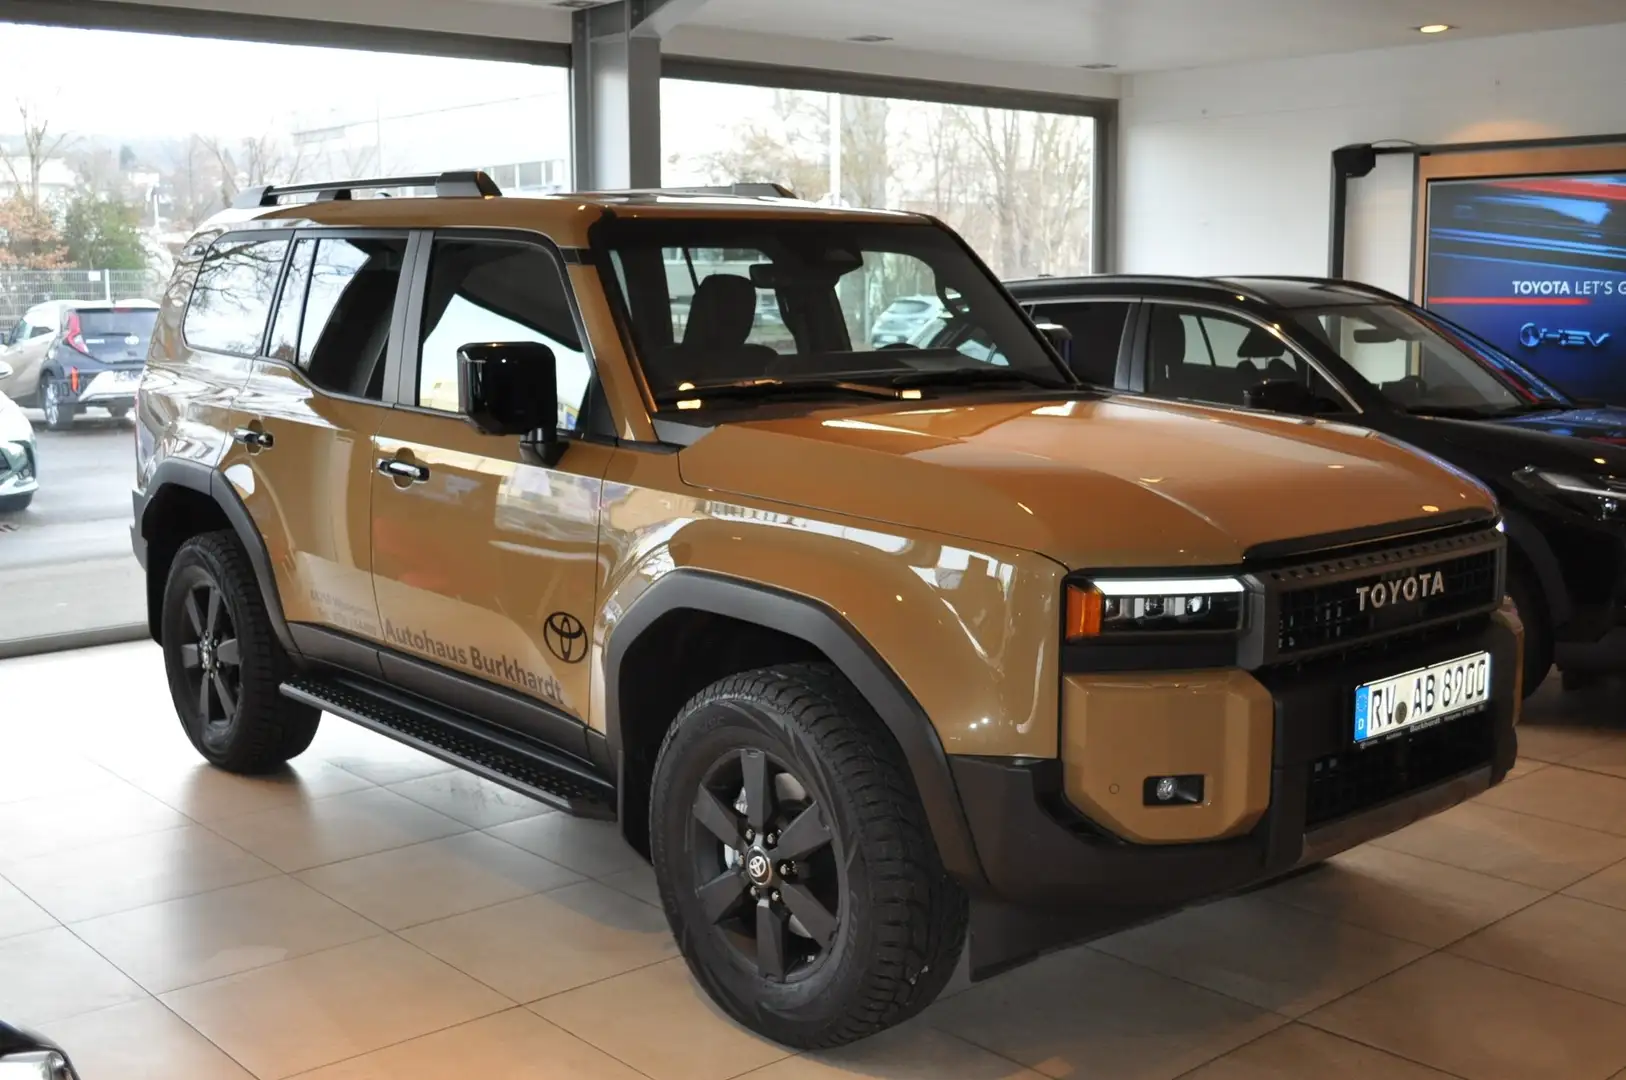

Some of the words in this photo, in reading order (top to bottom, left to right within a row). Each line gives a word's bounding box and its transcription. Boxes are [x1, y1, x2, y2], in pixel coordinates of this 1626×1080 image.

[1512, 280, 1571, 295] TOYOTA
[1574, 280, 1613, 295] LET'S
[1356, 571, 1445, 612] TOYOTA
[384, 618, 468, 666] Autohaus
[470, 646, 564, 704] Burkhardt
[1370, 684, 1397, 730] RV
[1411, 674, 1436, 718] AB
[1441, 659, 1486, 708] 8900
[1357, 717, 1365, 731] D
